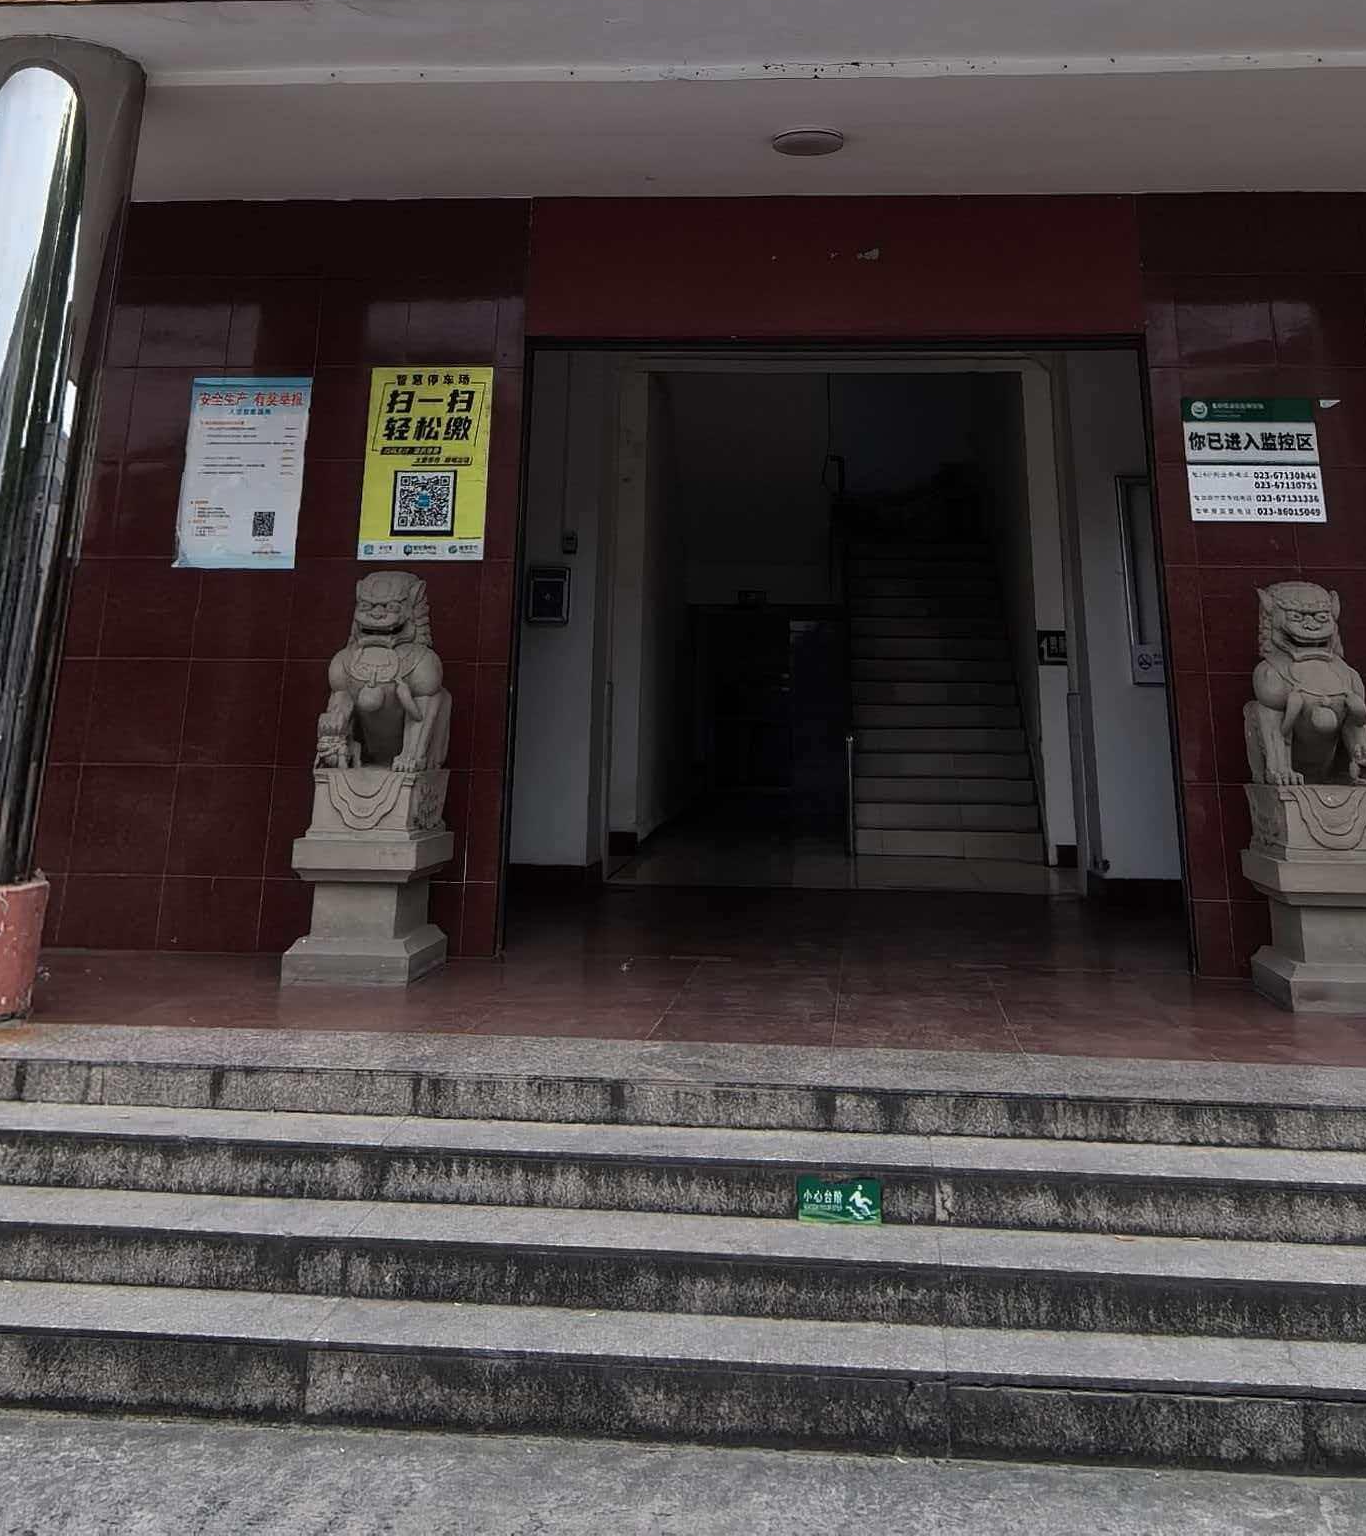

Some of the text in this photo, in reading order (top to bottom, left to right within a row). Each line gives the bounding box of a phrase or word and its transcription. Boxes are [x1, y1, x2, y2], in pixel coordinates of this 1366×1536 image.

[385, 389, 476, 414] 扫一扫
[382, 415, 473, 441] 轻松缴
[1188, 431, 1315, 452] 你已进入监控区
[803, 1188, 844, 1205] 小心台阶
